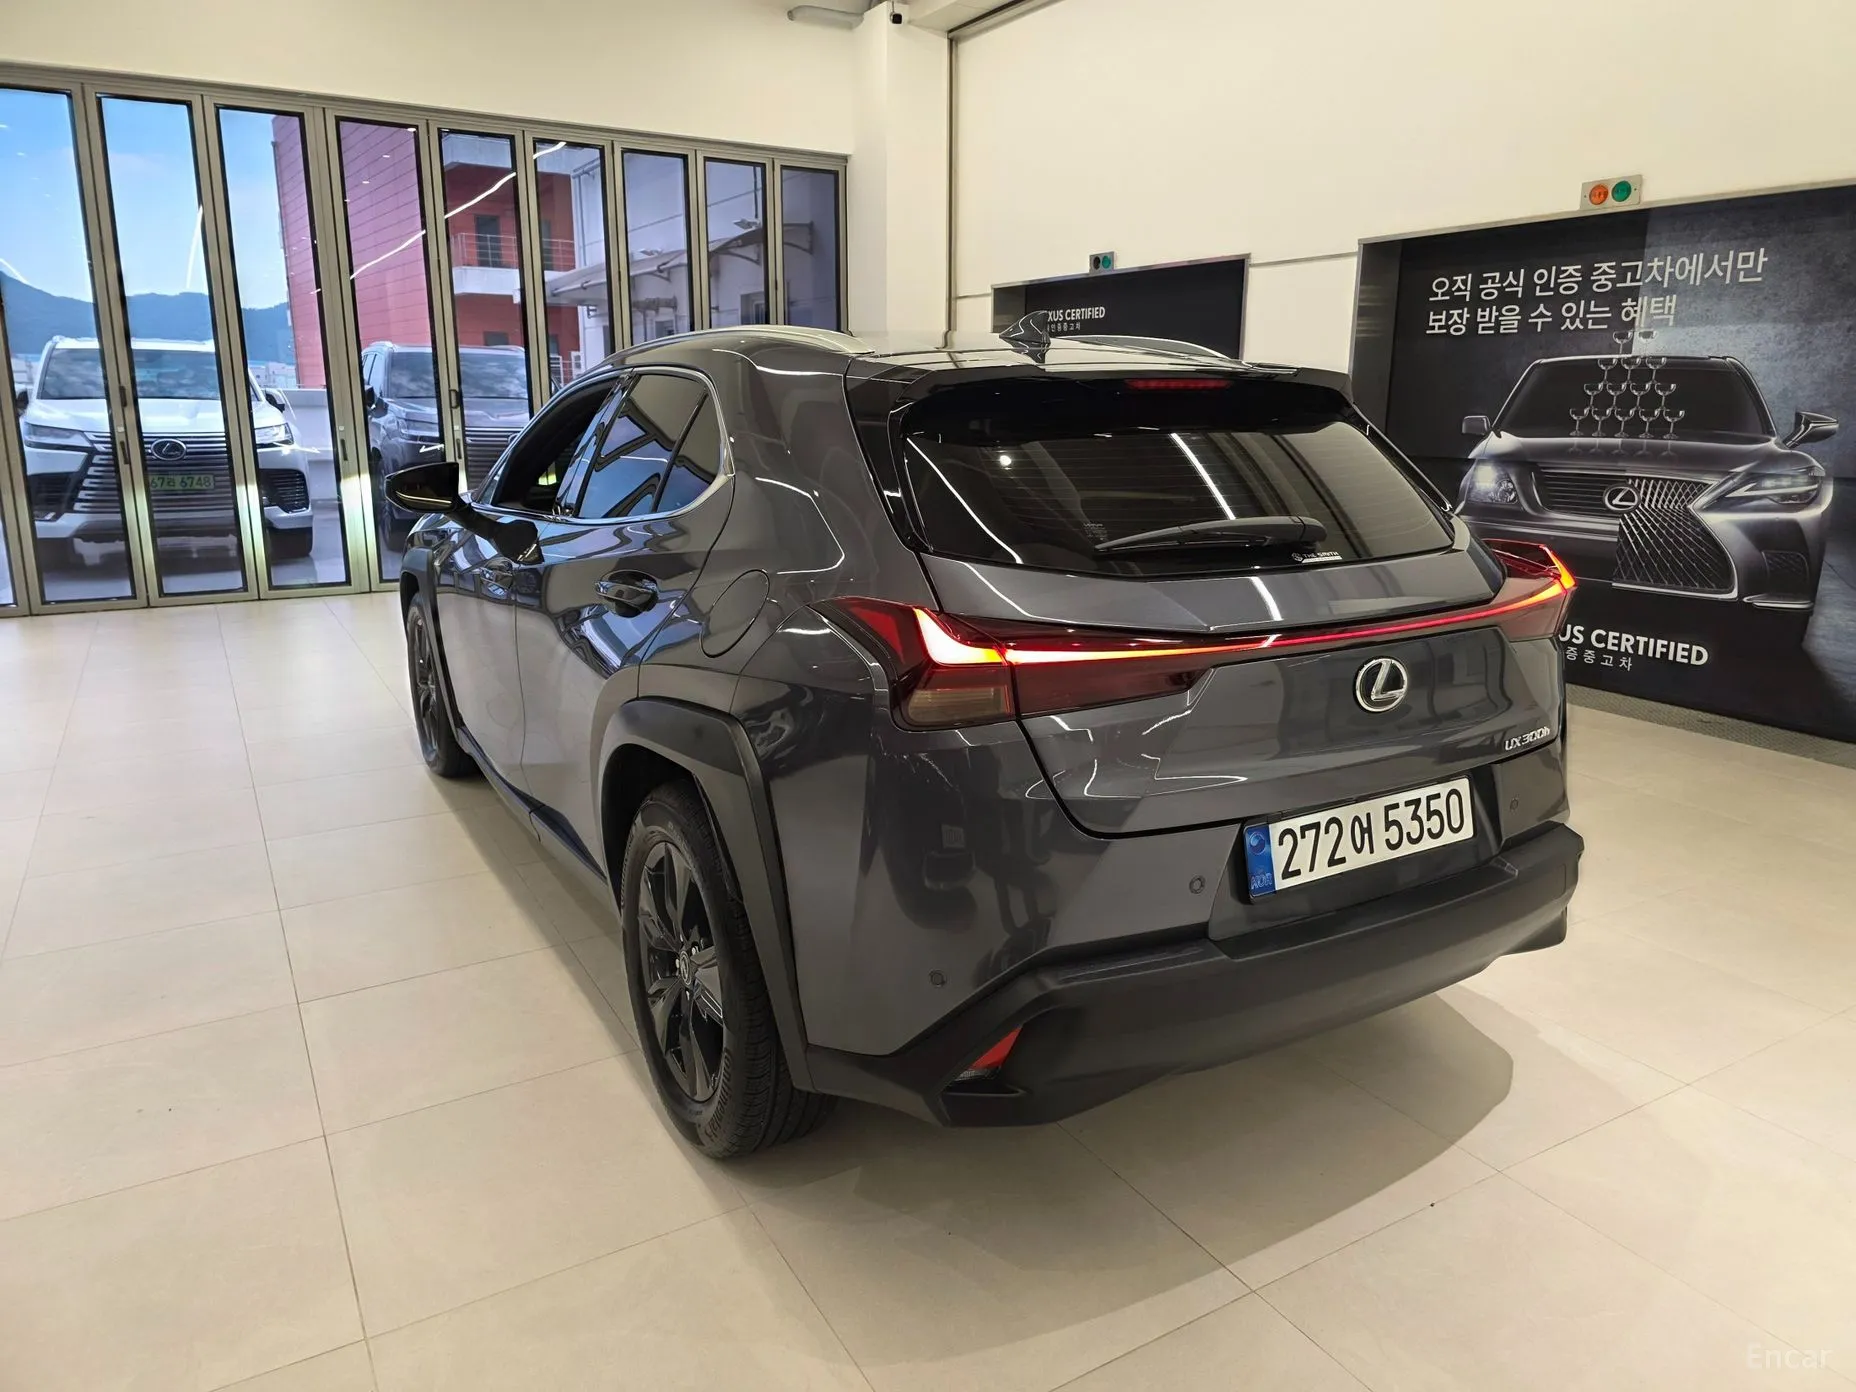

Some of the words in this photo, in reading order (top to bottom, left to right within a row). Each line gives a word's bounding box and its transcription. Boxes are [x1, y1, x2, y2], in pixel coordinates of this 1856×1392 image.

[1429, 273, 1472, 301] 오직
[1479, 268, 1525, 300] 공식
[1533, 265, 1582, 297] 인증
[1590, 247, 1768, 292] 중고차에서만
[1047, 310, 1063, 322] XUS
[1065, 306, 1105, 321] CERTIFIED
[1426, 307, 1470, 336] 보장
[1477, 305, 1522, 334] 받을
[1528, 303, 1552, 332] 수
[1561, 300, 1612, 331] 있는
[1621, 294, 1677, 327] 혜택
[1558, 624, 1585, 644] US
[1590, 629, 1709, 666] CERTIFIED
[1566, 646, 1633, 672] 증중고차
[1505, 736, 1521, 750] UX
[1278, 811, 1375, 881] 272어
[1384, 787, 1466, 851] 5350
